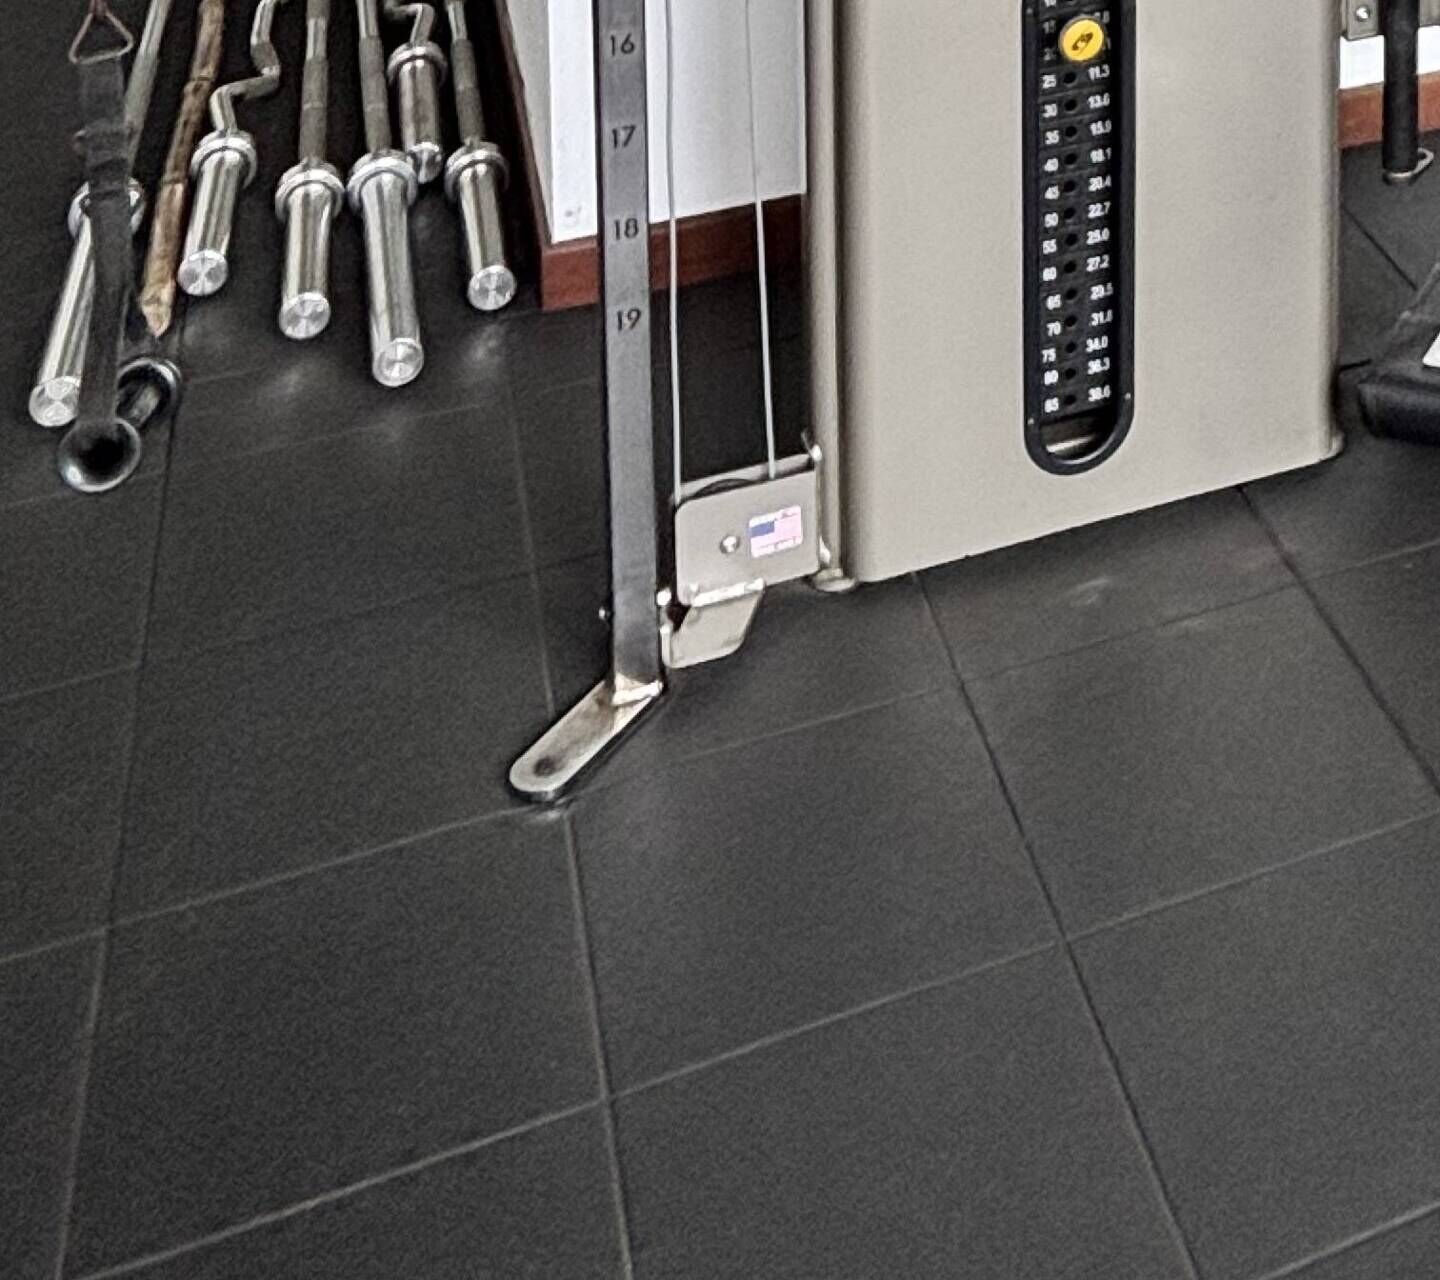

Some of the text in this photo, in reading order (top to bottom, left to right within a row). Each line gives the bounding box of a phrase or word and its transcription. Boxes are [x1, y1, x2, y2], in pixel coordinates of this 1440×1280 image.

[609, 33, 635, 55] 16
[610, 125, 637, 148] 17
[613, 216, 639, 239] 18
[616, 309, 642, 332] 19
